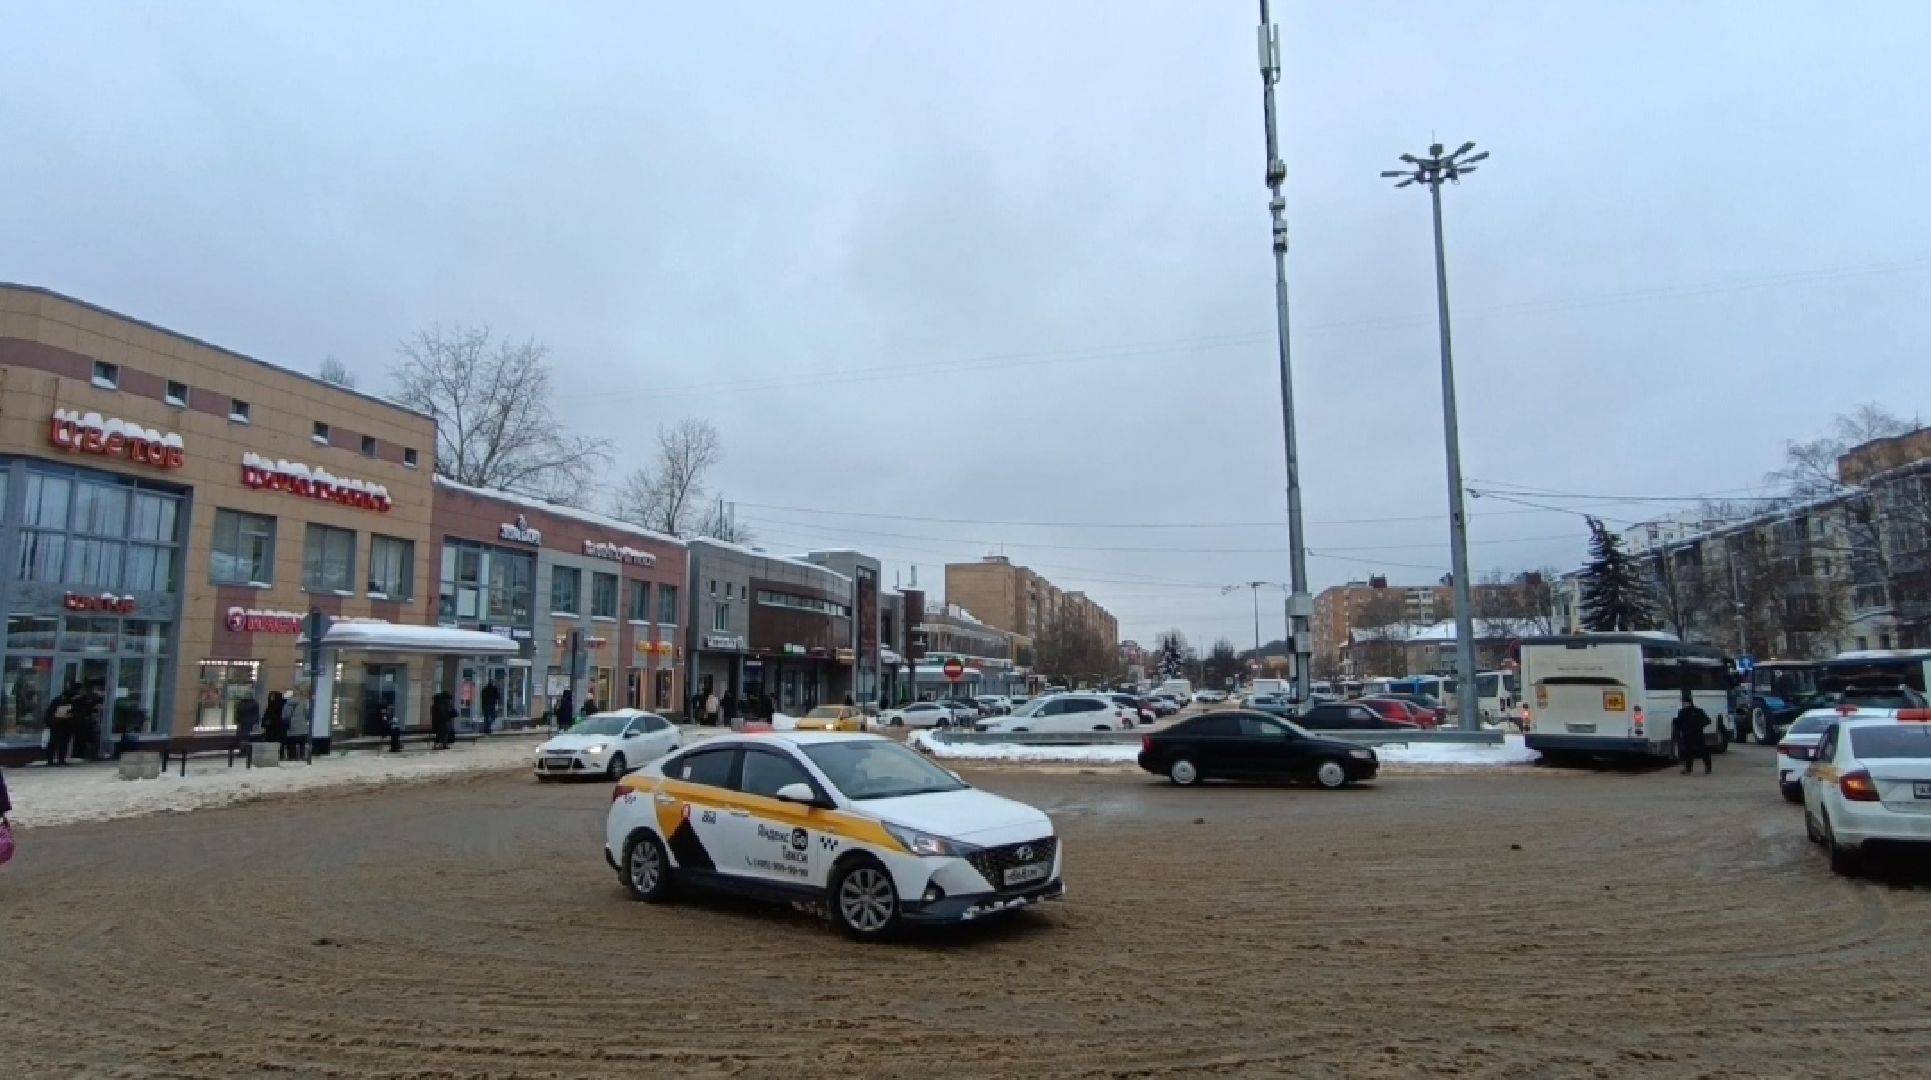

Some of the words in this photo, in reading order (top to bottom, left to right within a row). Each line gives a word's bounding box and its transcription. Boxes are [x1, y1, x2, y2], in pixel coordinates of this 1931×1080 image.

[758, 824, 790, 842] Яндекс
[793, 829, 808, 849] Go
[782, 845, 808, 863] Такси
